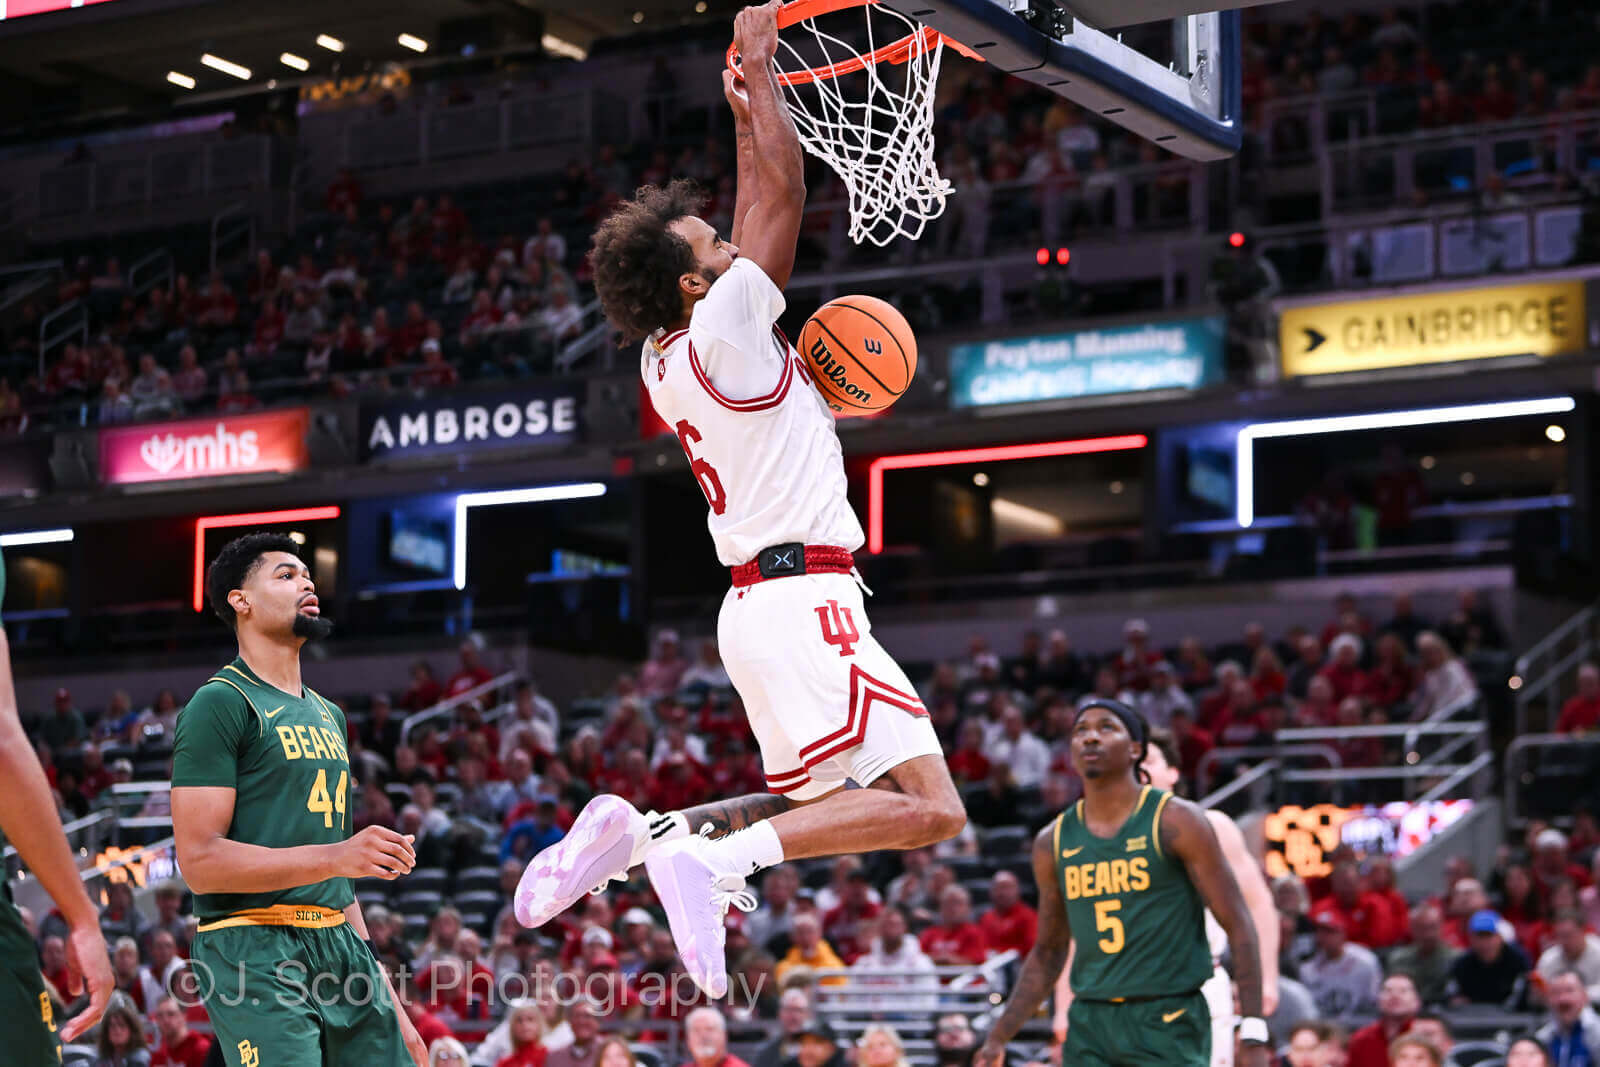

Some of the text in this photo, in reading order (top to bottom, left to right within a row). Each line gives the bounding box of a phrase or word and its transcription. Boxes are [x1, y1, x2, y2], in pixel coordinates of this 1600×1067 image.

[1341, 294, 1569, 352] GAINBRIDGE
[810, 337, 872, 403] Wilson
[184, 424, 259, 472] mhs
[369, 397, 577, 449] AMBROSE
[676, 418, 728, 516] 6
[306, 768, 348, 831] 44
[1064, 857, 1151, 900] BEARS
[1094, 899, 1125, 954] 5
